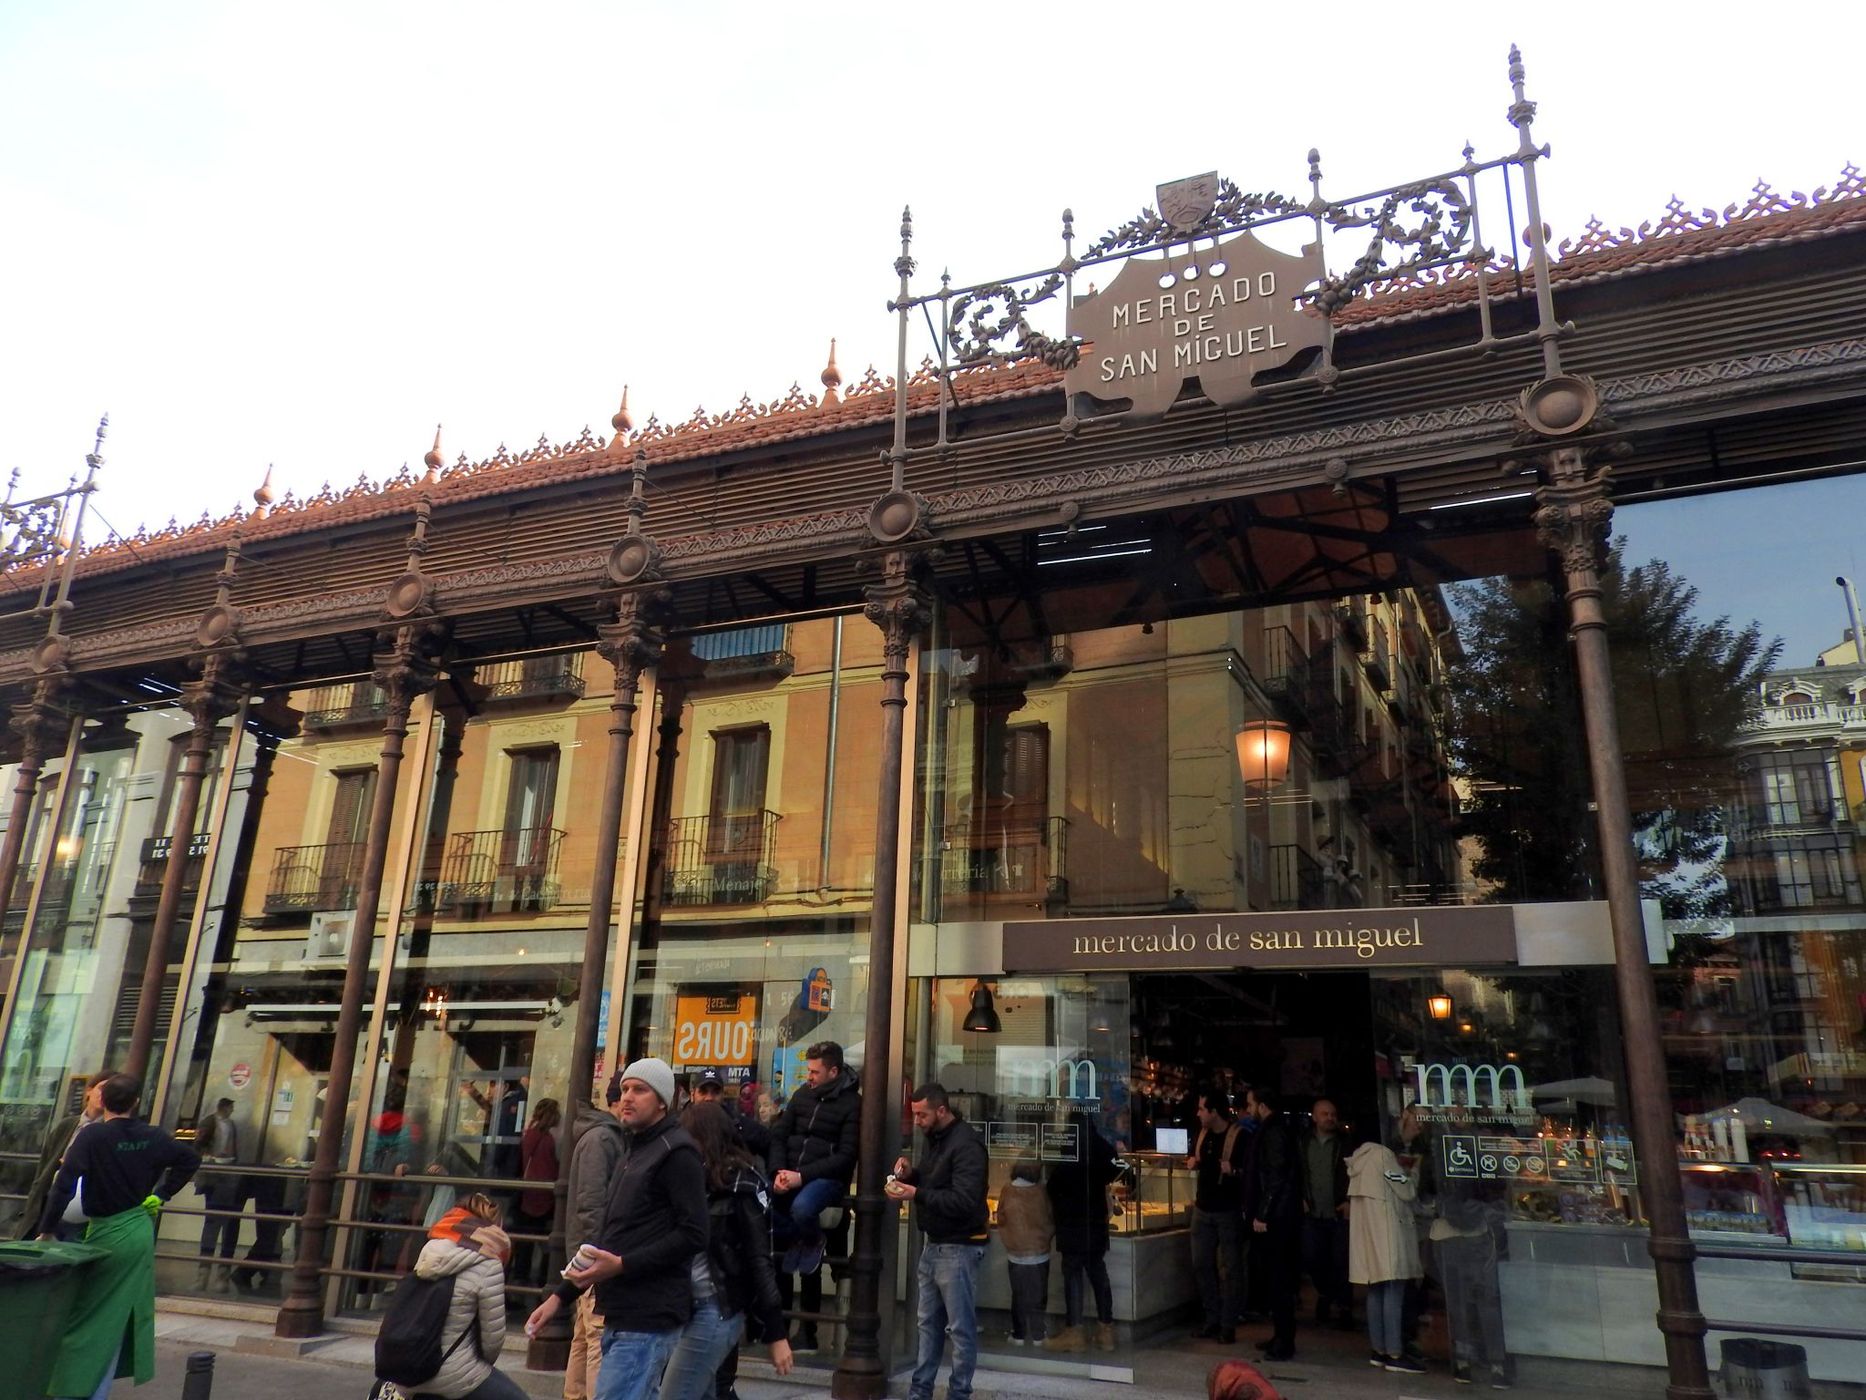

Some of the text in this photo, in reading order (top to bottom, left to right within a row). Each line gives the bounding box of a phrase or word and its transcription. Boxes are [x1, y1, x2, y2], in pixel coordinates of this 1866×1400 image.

[1112, 271, 1277, 328] MERCADO
[1174, 314, 1214, 337] DE
[1101, 348, 1157, 382] SAN
[1072, 917, 1424, 959] mercado de san miguel
[1416, 1112, 1460, 1123] mercado
[1462, 1112, 1475, 1123] de
[1477, 1114, 1495, 1123] san
